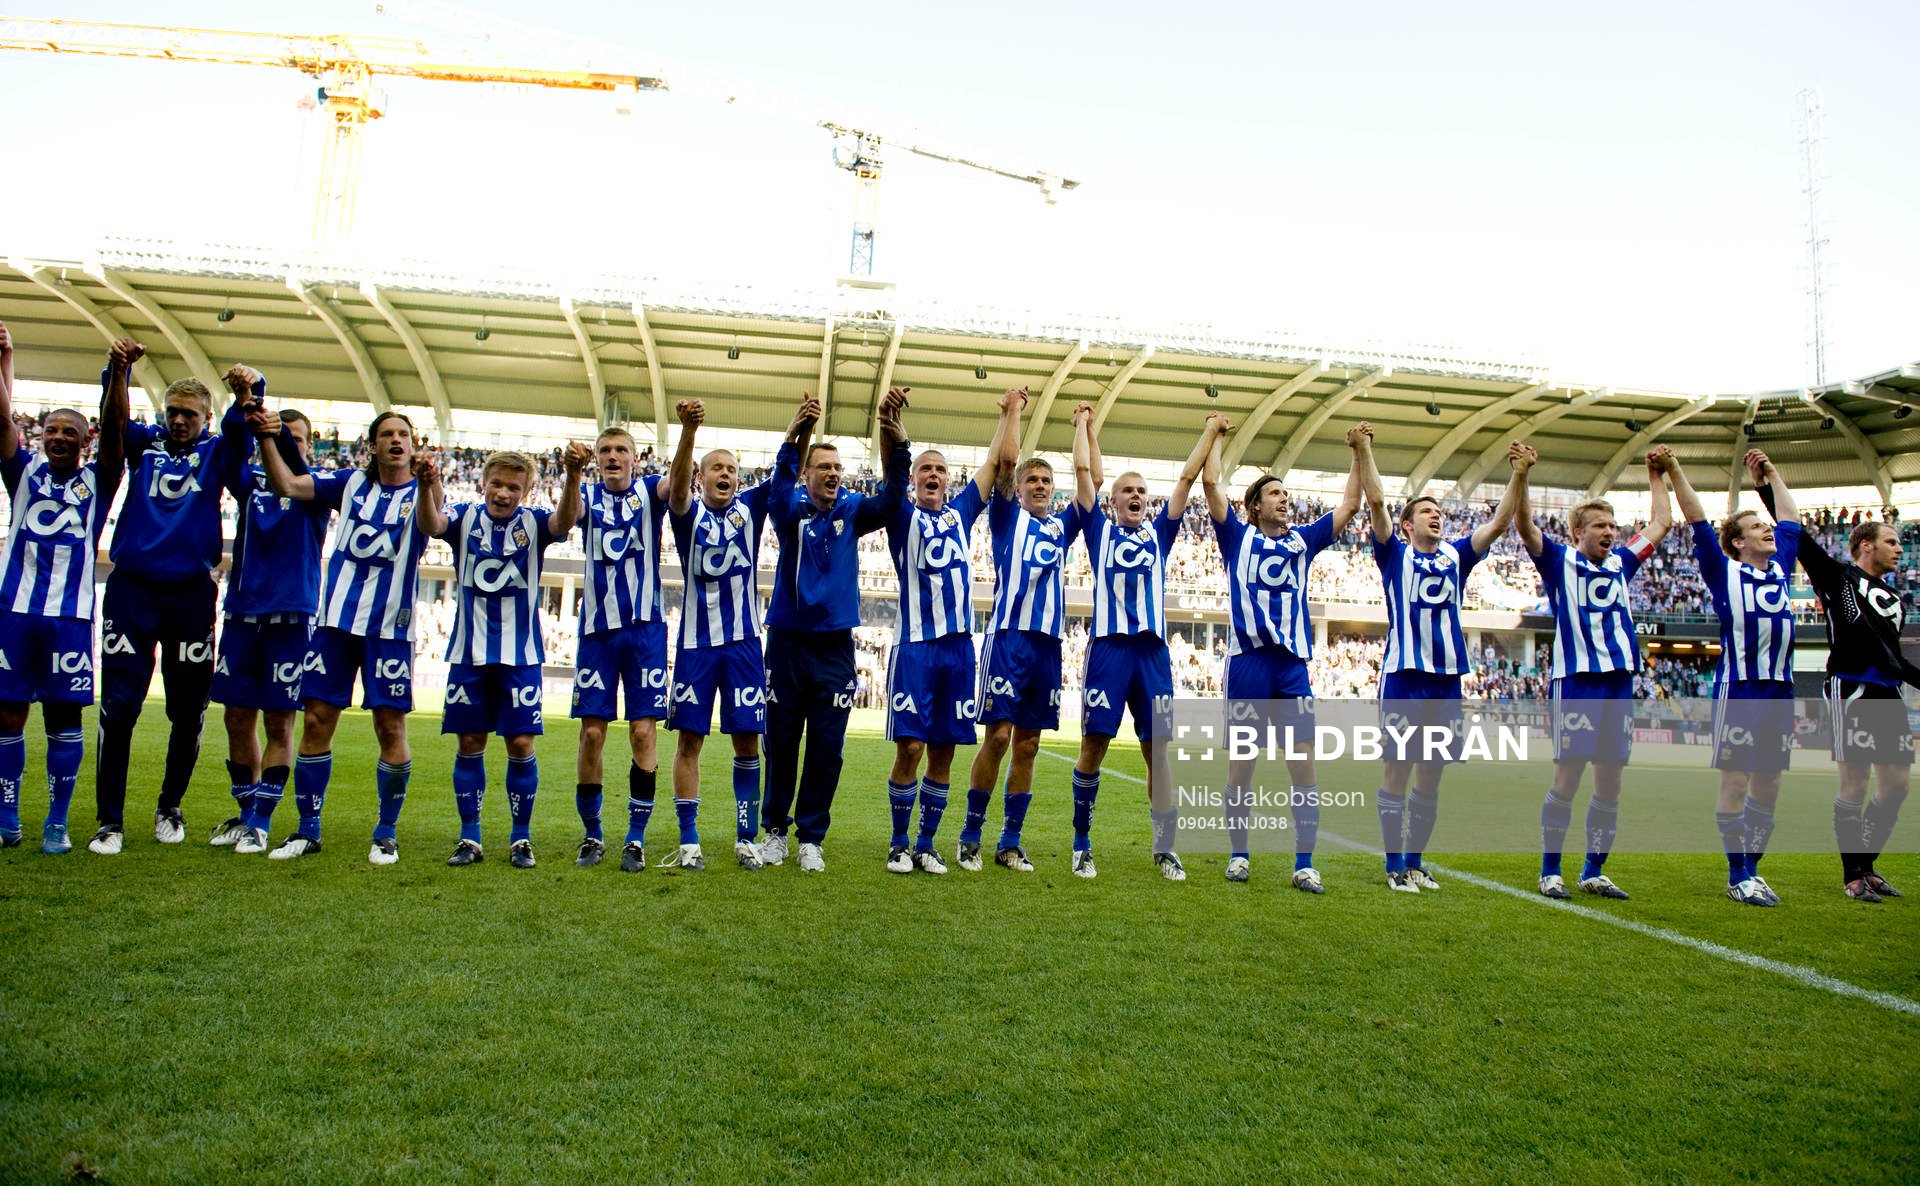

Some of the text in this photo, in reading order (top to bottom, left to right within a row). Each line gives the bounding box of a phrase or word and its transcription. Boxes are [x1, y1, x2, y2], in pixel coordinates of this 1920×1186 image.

[153, 457, 166, 468] 12
[149, 469, 202, 499] ICA
[338, 519, 397, 562] ICA
[593, 526, 645, 561] ICA
[918, 535, 966, 569] ICA
[693, 540, 752, 577] ICA
[1106, 539, 1155, 571] ICA
[463, 553, 529, 593] ICA
[1247, 553, 1300, 590] ICA
[1410, 572, 1457, 604] ICA
[1578, 576, 1627, 608] ICA
[1743, 583, 1794, 615] ICA
[1858, 578, 1904, 633] ICA
[52, 651, 94, 673] ICA
[374, 658, 412, 680] ICA
[70, 677, 92, 691] 22
[285, 685, 301, 701] 14
[388, 683, 406, 697] 13
[734, 686, 767, 708] ICA
[1155, 694, 1174, 714] IC
[755, 708, 765, 722] 11
[1228, 701, 1260, 721] ICA
[1558, 712, 1594, 731] ICA
[1851, 716, 1859, 728] 1
[1721, 724, 1753, 747] ICA
[1847, 729, 1877, 751] ICA
[737, 800, 748, 829] SKF
